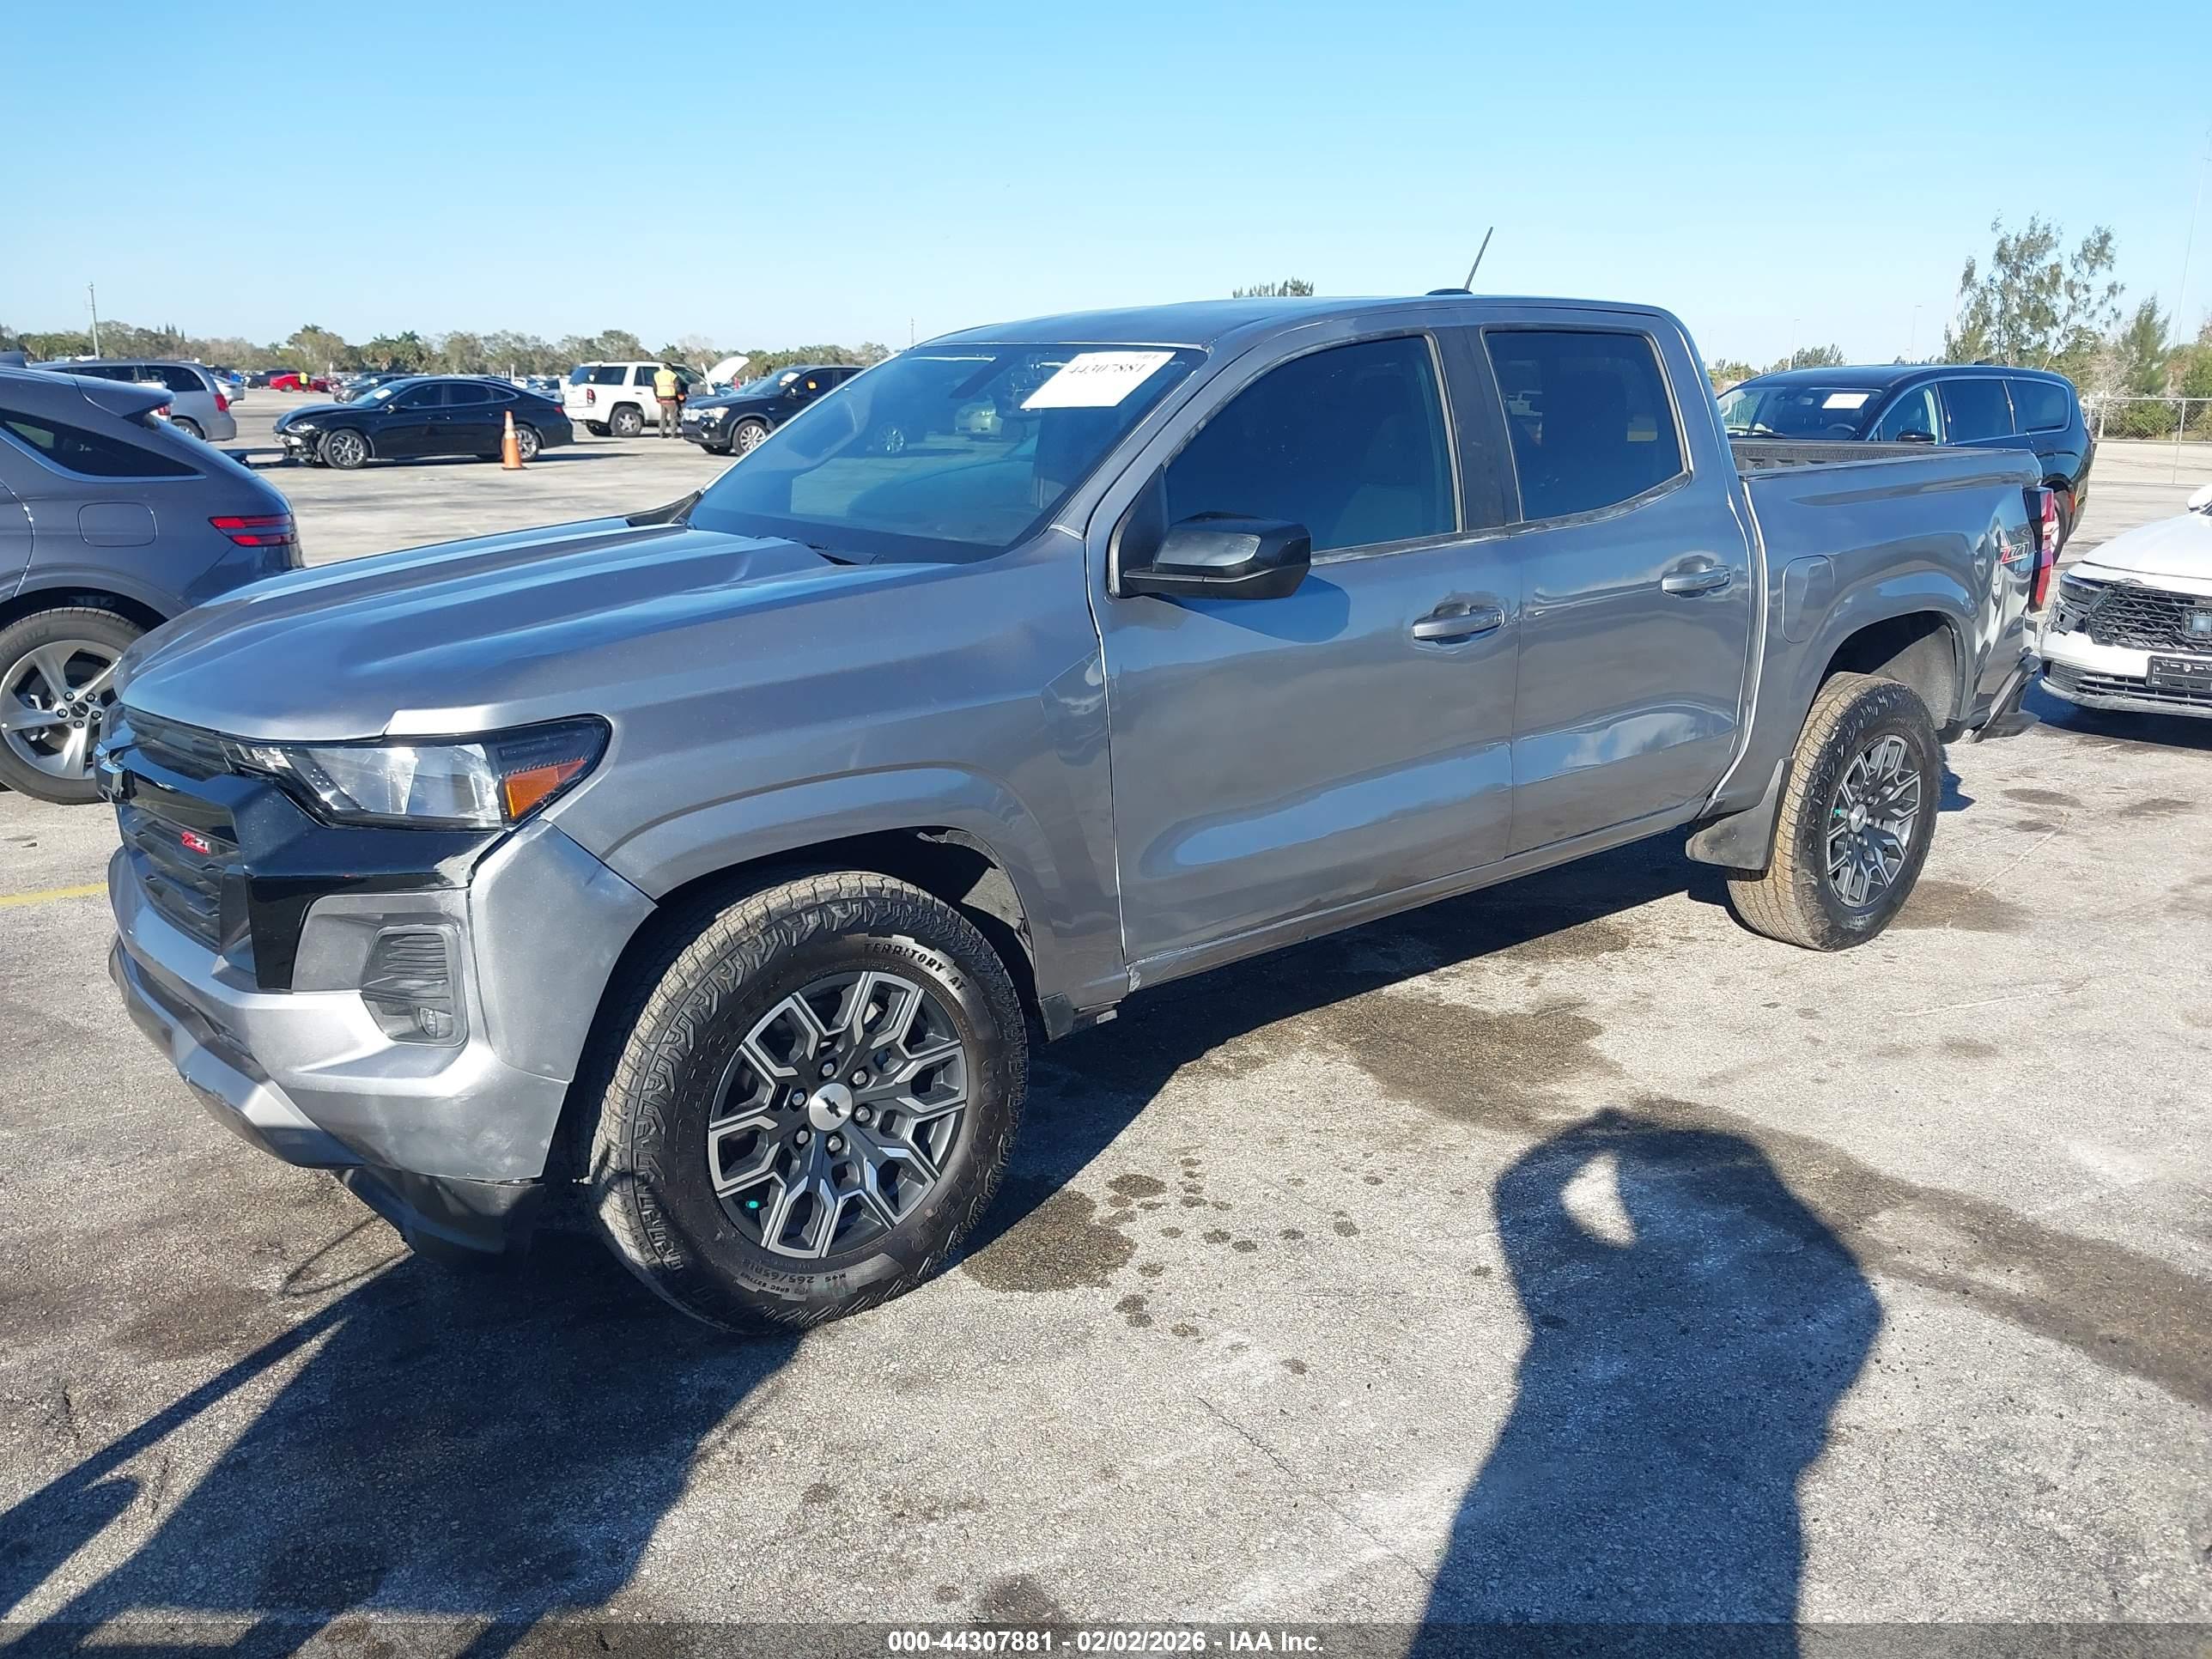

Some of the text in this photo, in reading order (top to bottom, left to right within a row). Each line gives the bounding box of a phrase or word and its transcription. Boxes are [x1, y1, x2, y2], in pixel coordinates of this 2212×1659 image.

[2001, 541, 2030, 564] Z71
[863, 943, 945, 972] TERRITORY
[948, 975, 967, 990] AT
